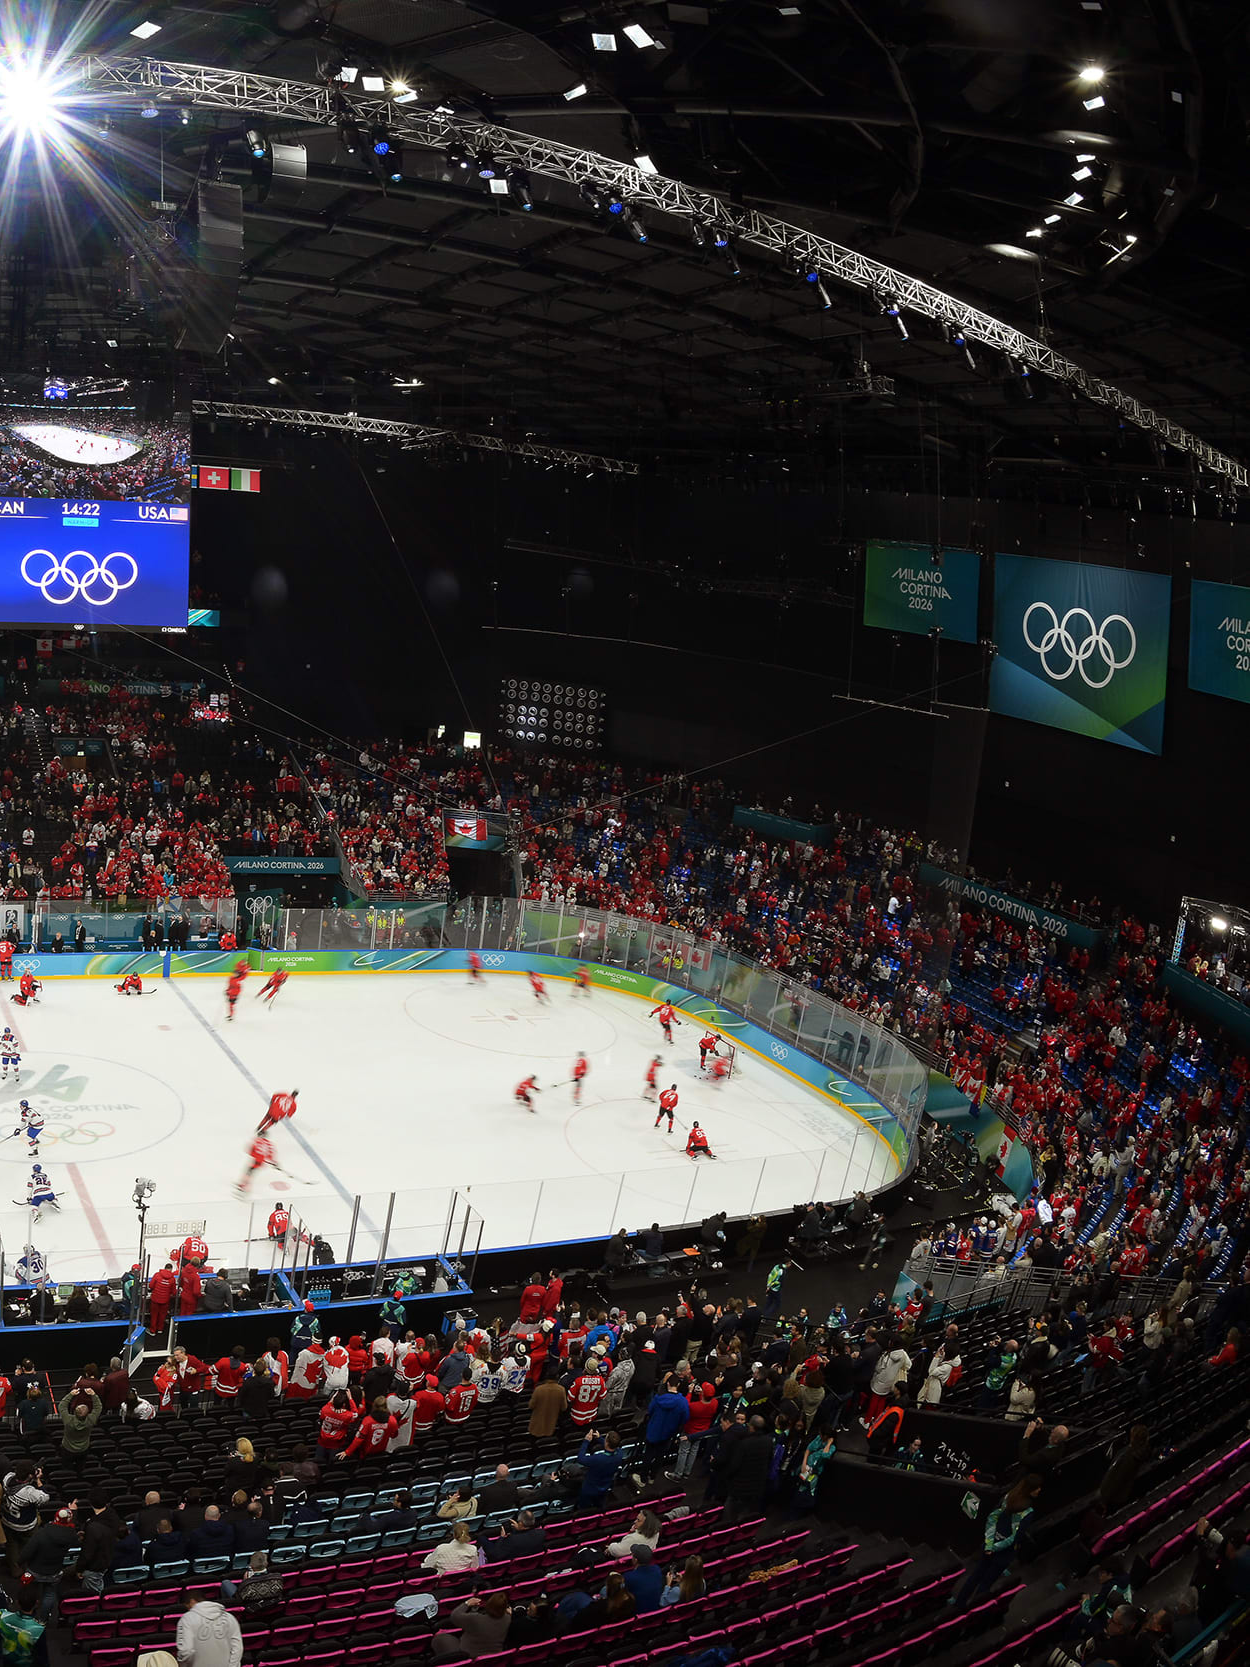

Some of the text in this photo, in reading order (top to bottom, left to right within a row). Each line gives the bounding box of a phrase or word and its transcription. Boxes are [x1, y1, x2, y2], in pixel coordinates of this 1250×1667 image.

[61, 502, 100, 516] 14:22
[138, 505, 170, 520] USA
[891, 567, 943, 584] MILANO
[900, 581, 952, 600] CORTINA
[908, 596, 933, 611] 2026
[1235, 654, 1250, 672] 20
[233, 861, 325, 870] MILANO CORTINA 2026
[938, 877, 1068, 937] MILANO CORTINA 2026
[50, 1103, 141, 1113] CORTINA
[43, 1112, 74, 1120] 026
[191, 1241, 206, 1253] 50
[578, 1385, 601, 1403] 87
